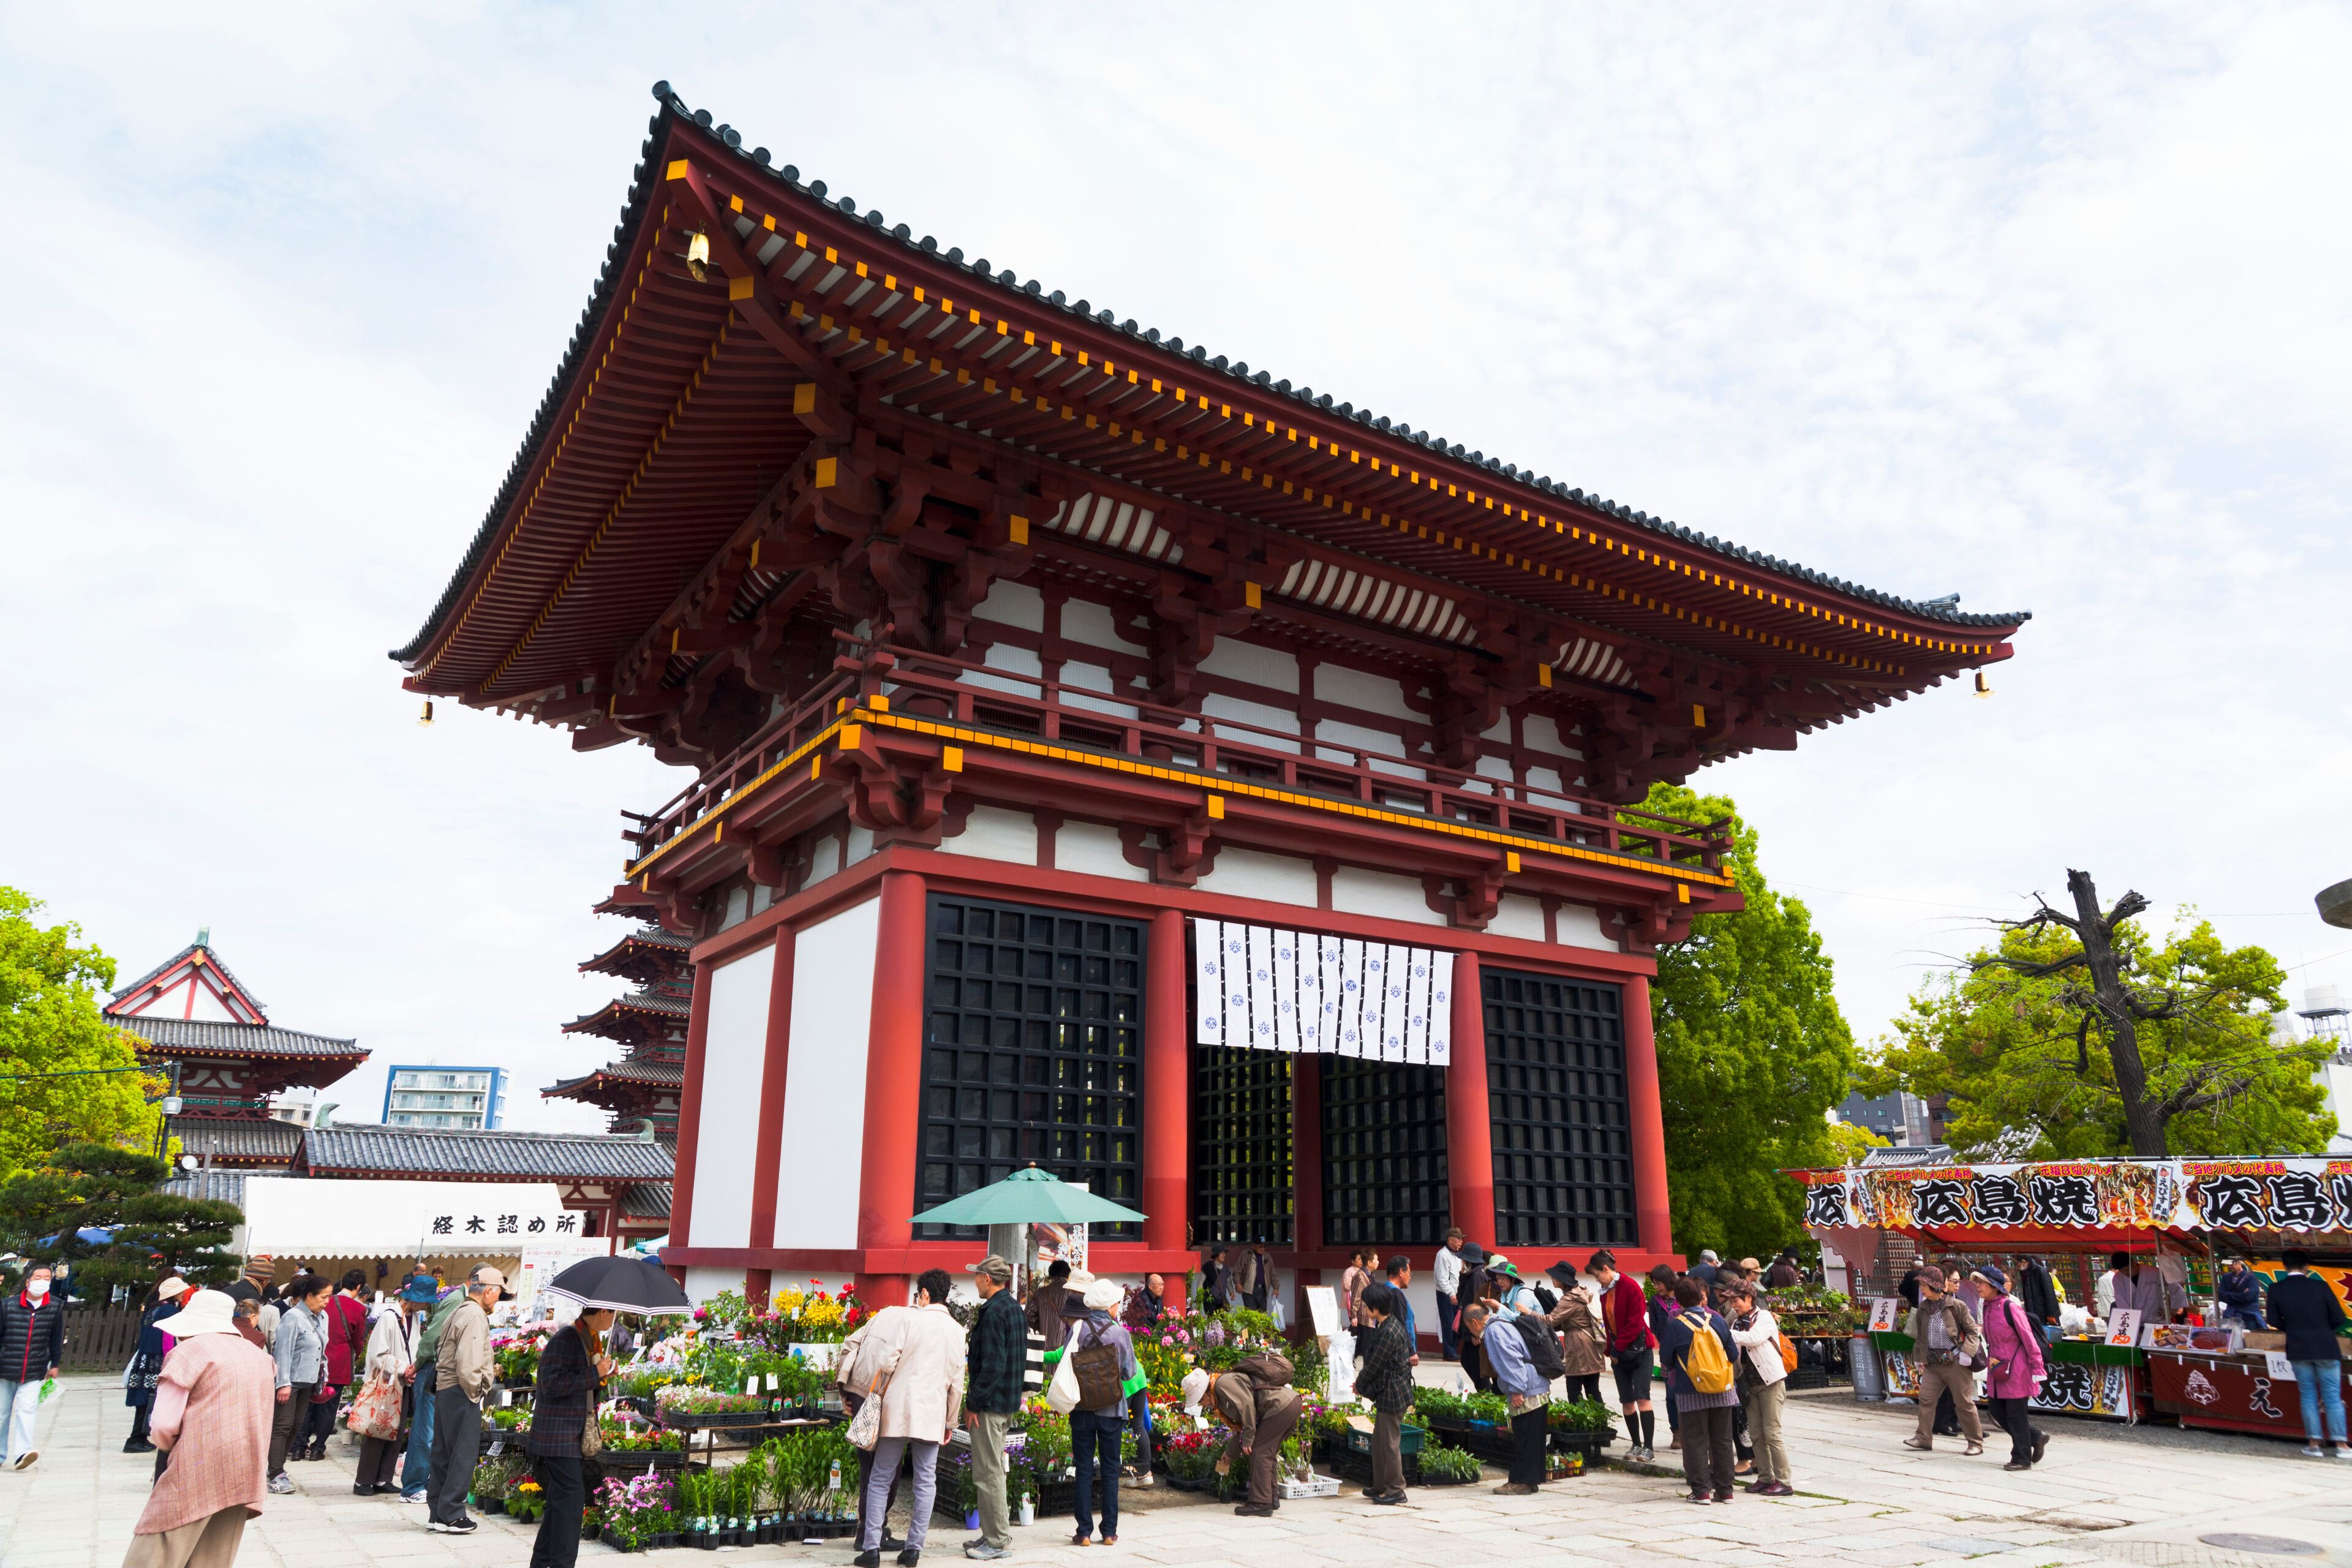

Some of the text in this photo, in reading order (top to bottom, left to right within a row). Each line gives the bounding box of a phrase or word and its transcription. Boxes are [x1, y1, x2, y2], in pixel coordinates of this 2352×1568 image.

[1885, 1167, 1973, 1181] ご当地グルメの代表格
[2038, 1164, 2113, 1177] 元祖B級グルメ
[2182, 1161, 2286, 1175] ご当地グルメの代表格
[1807, 1182, 1848, 1227] 広
[1911, 1174, 2100, 1226] 広島焼
[2155, 1177, 2168, 1215] えびす食品
[432, 1214, 576, 1235] 経木認め所
[2112, 1335, 2131, 1344] 150
[2249, 1378, 2283, 1418] え
